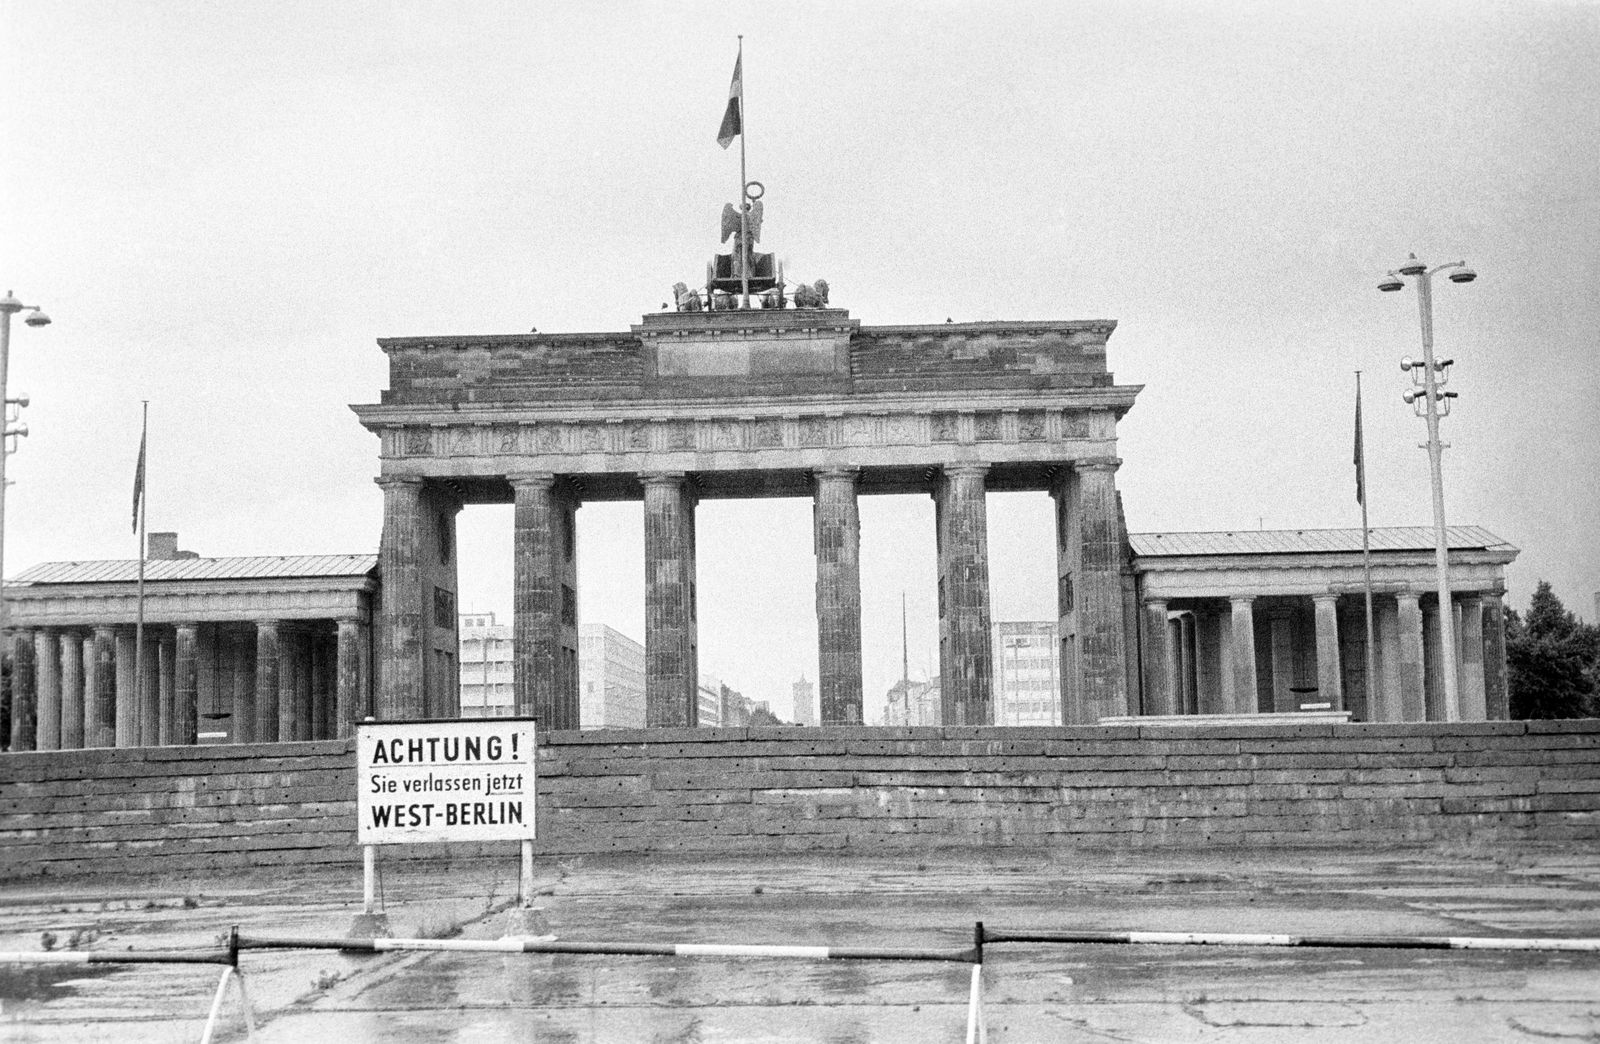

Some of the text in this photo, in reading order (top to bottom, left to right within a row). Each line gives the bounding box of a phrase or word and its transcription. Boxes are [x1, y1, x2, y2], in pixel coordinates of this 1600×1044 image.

[373, 733, 519, 764] ACHTUNG!
[371, 772, 523, 796] Sie verlassen jetzt
[371, 801, 523, 828] WEST-BERLIN
